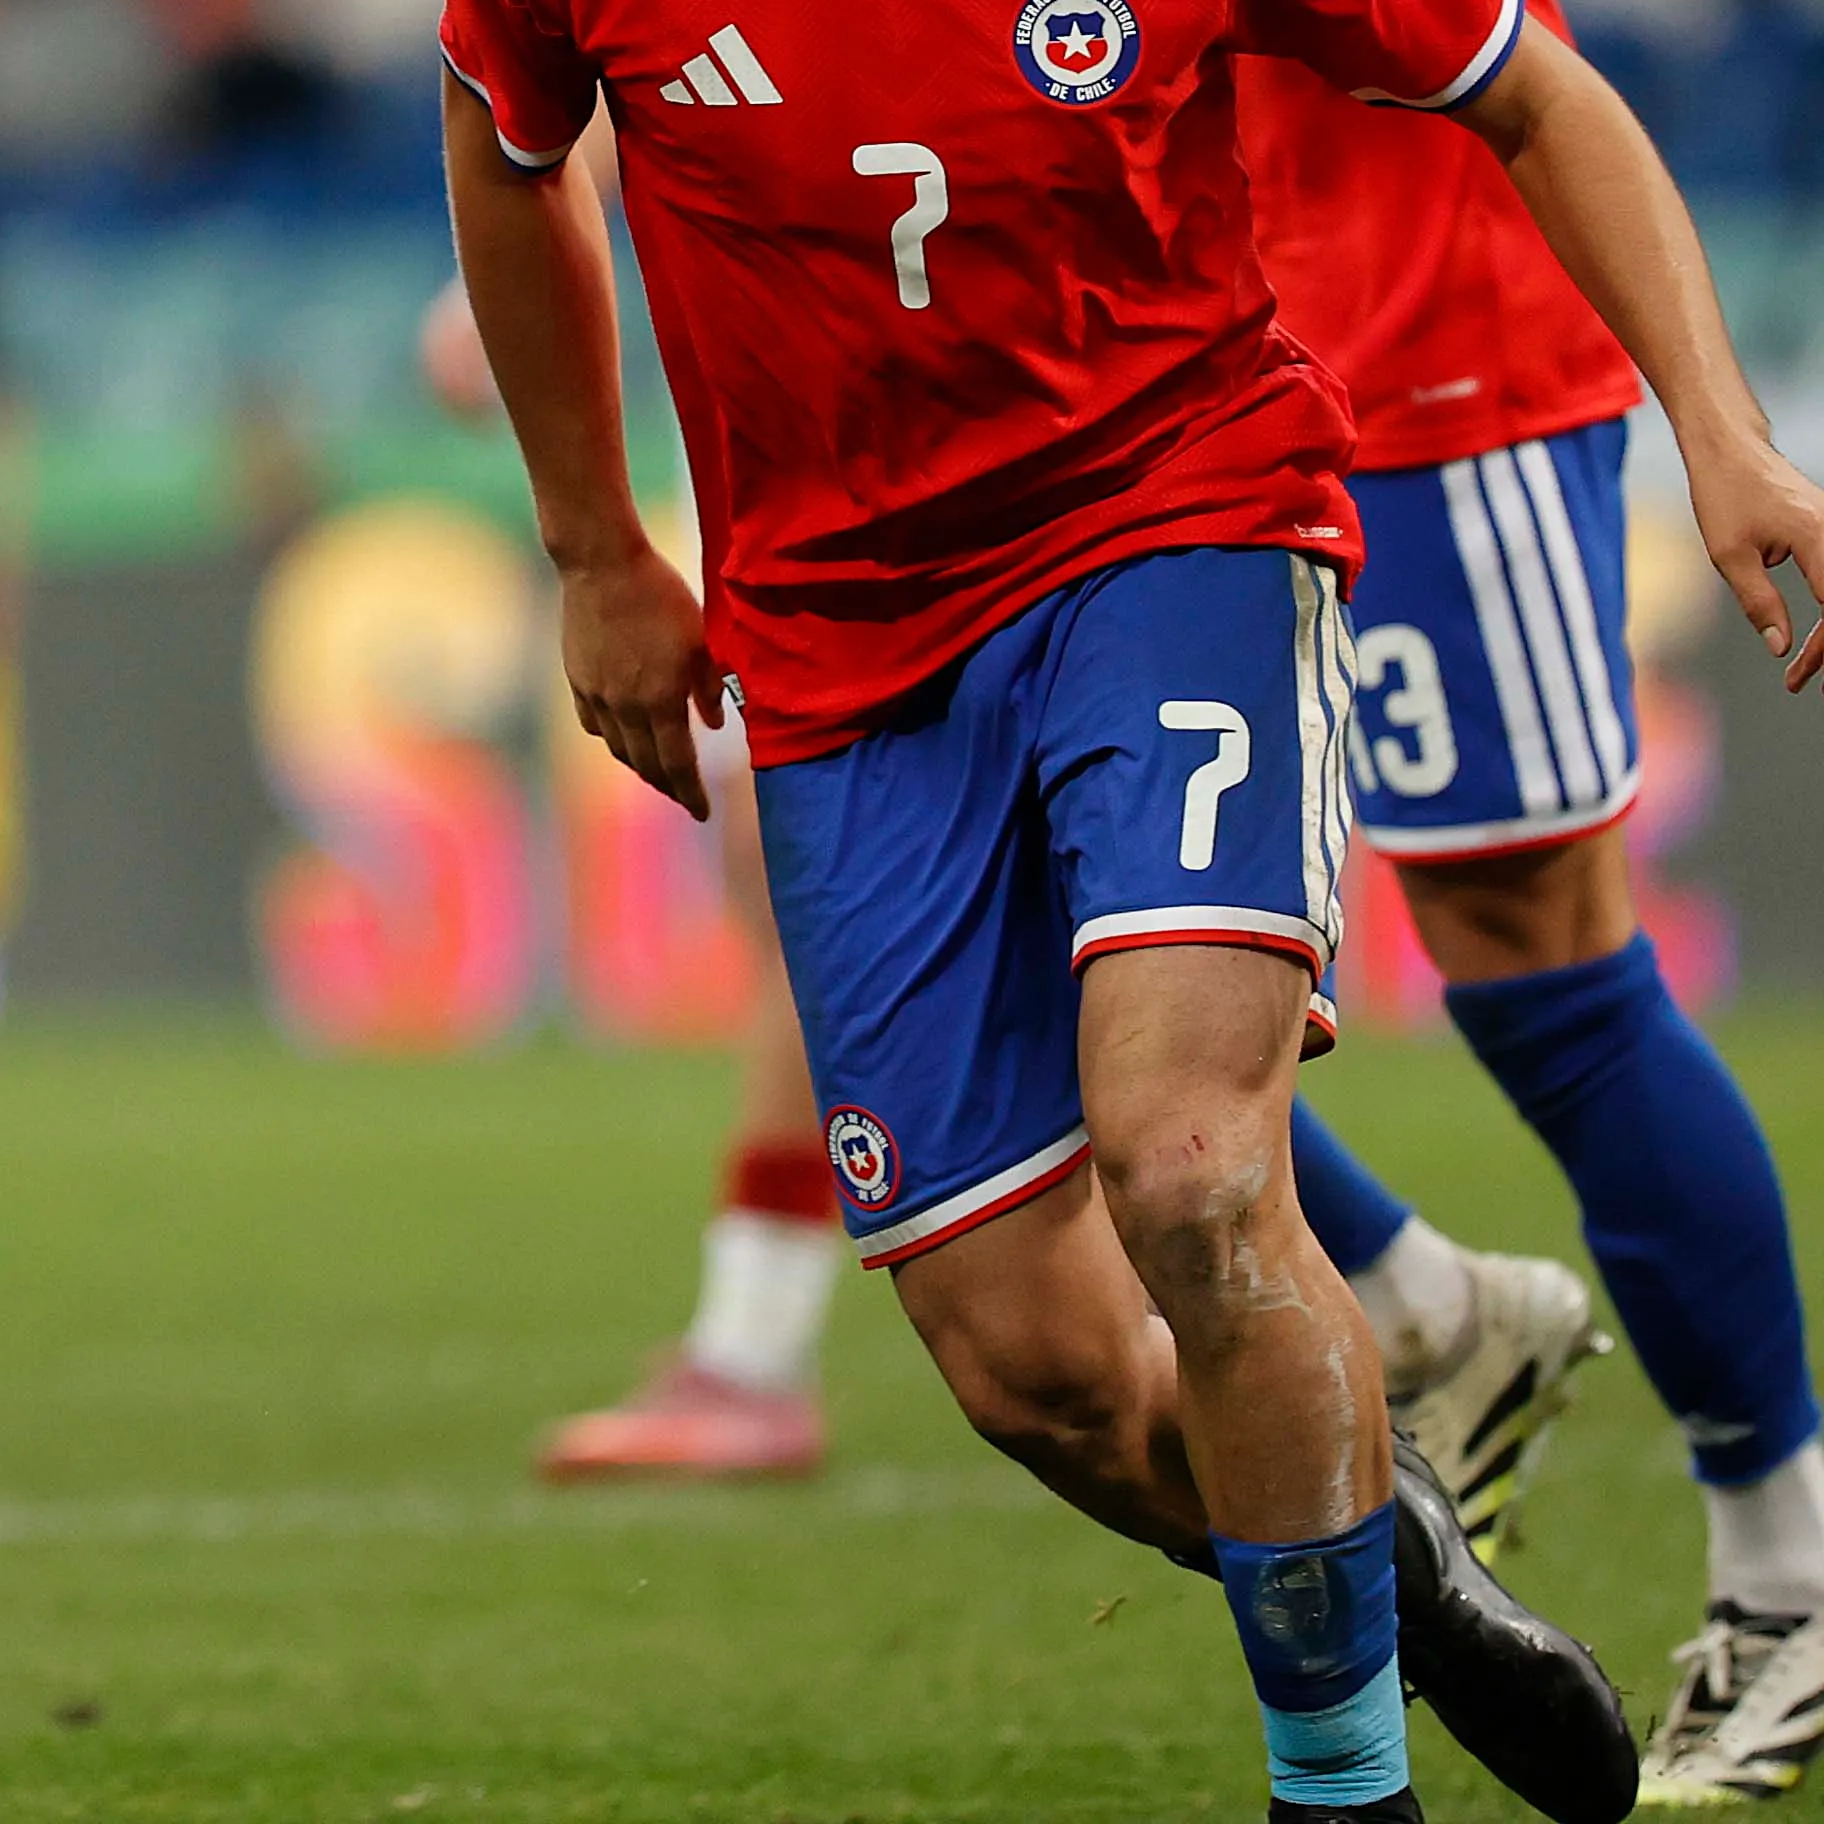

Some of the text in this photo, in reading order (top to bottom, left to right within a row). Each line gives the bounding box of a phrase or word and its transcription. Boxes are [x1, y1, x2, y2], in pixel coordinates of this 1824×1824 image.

[1049, 77, 1115, 101] DE CHILE
[852, 142, 949, 309] 7
[1158, 700, 1251, 871] 7
